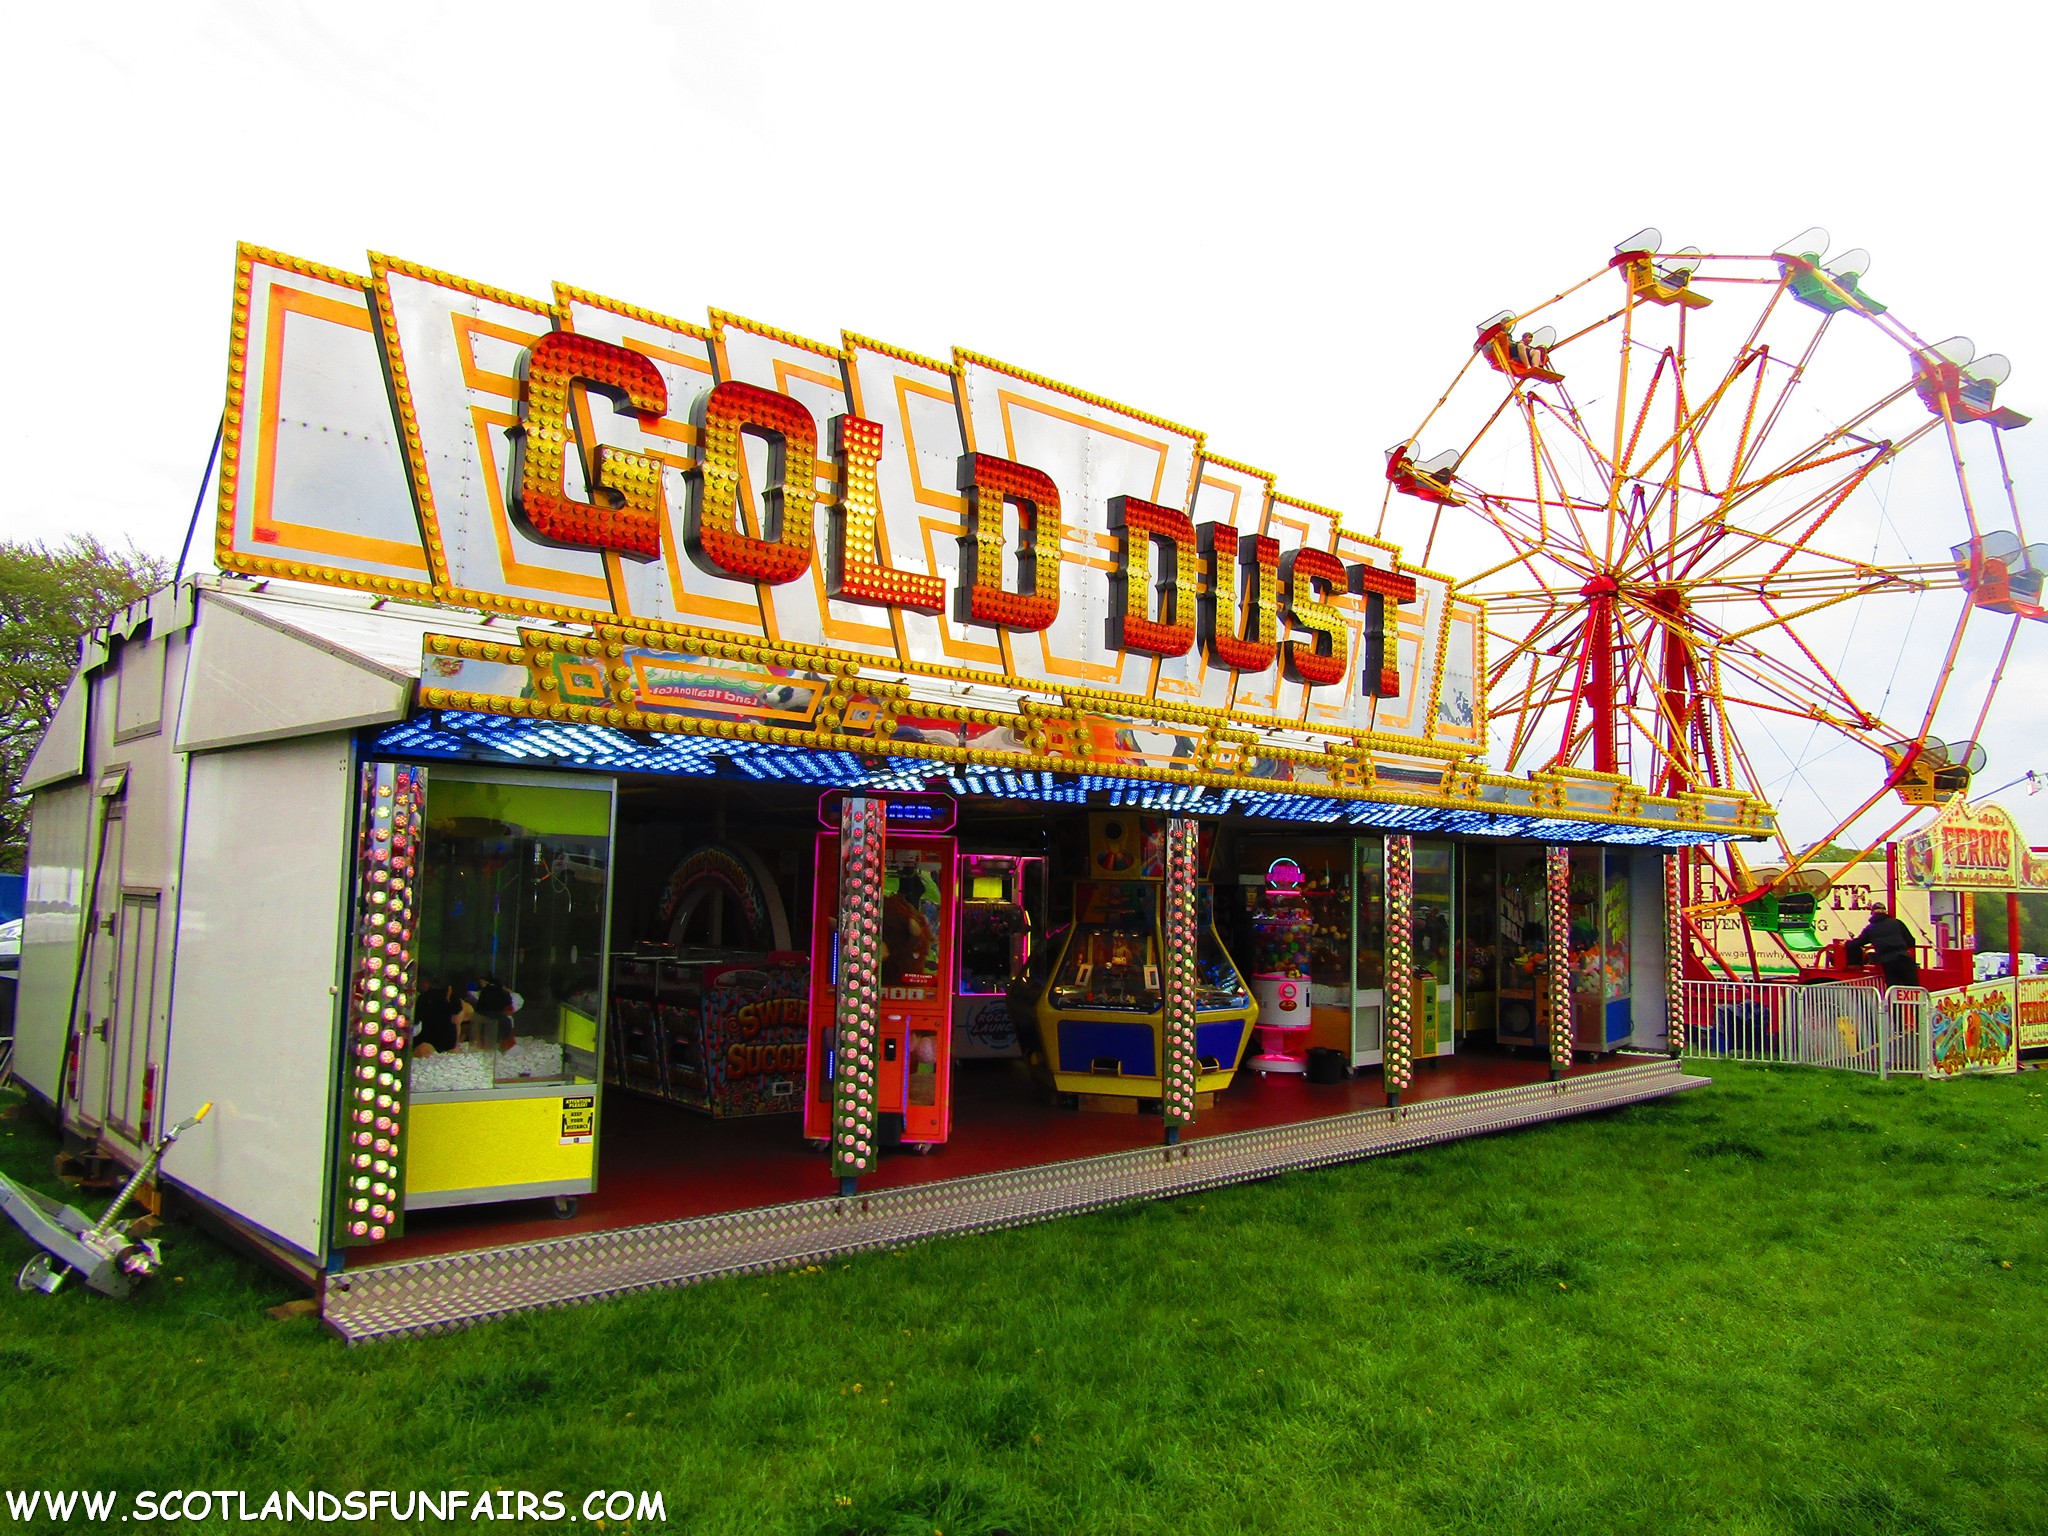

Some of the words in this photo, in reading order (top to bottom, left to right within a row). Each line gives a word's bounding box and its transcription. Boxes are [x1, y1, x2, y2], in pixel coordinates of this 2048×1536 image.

[505, 331, 1061, 633] GOLD
[1105, 494, 1416, 698] DUST
[1942, 826, 2010, 870] FERRIS
[1702, 918, 1741, 930] EVEN
[1896, 989, 1920, 1001] EXIT
[738, 998, 809, 1037] SWEE
[972, 1023, 1014, 1033] LAUNC
[977, 1013, 1011, 1023] ROCK
[726, 1043, 807, 1080] SUCCE
